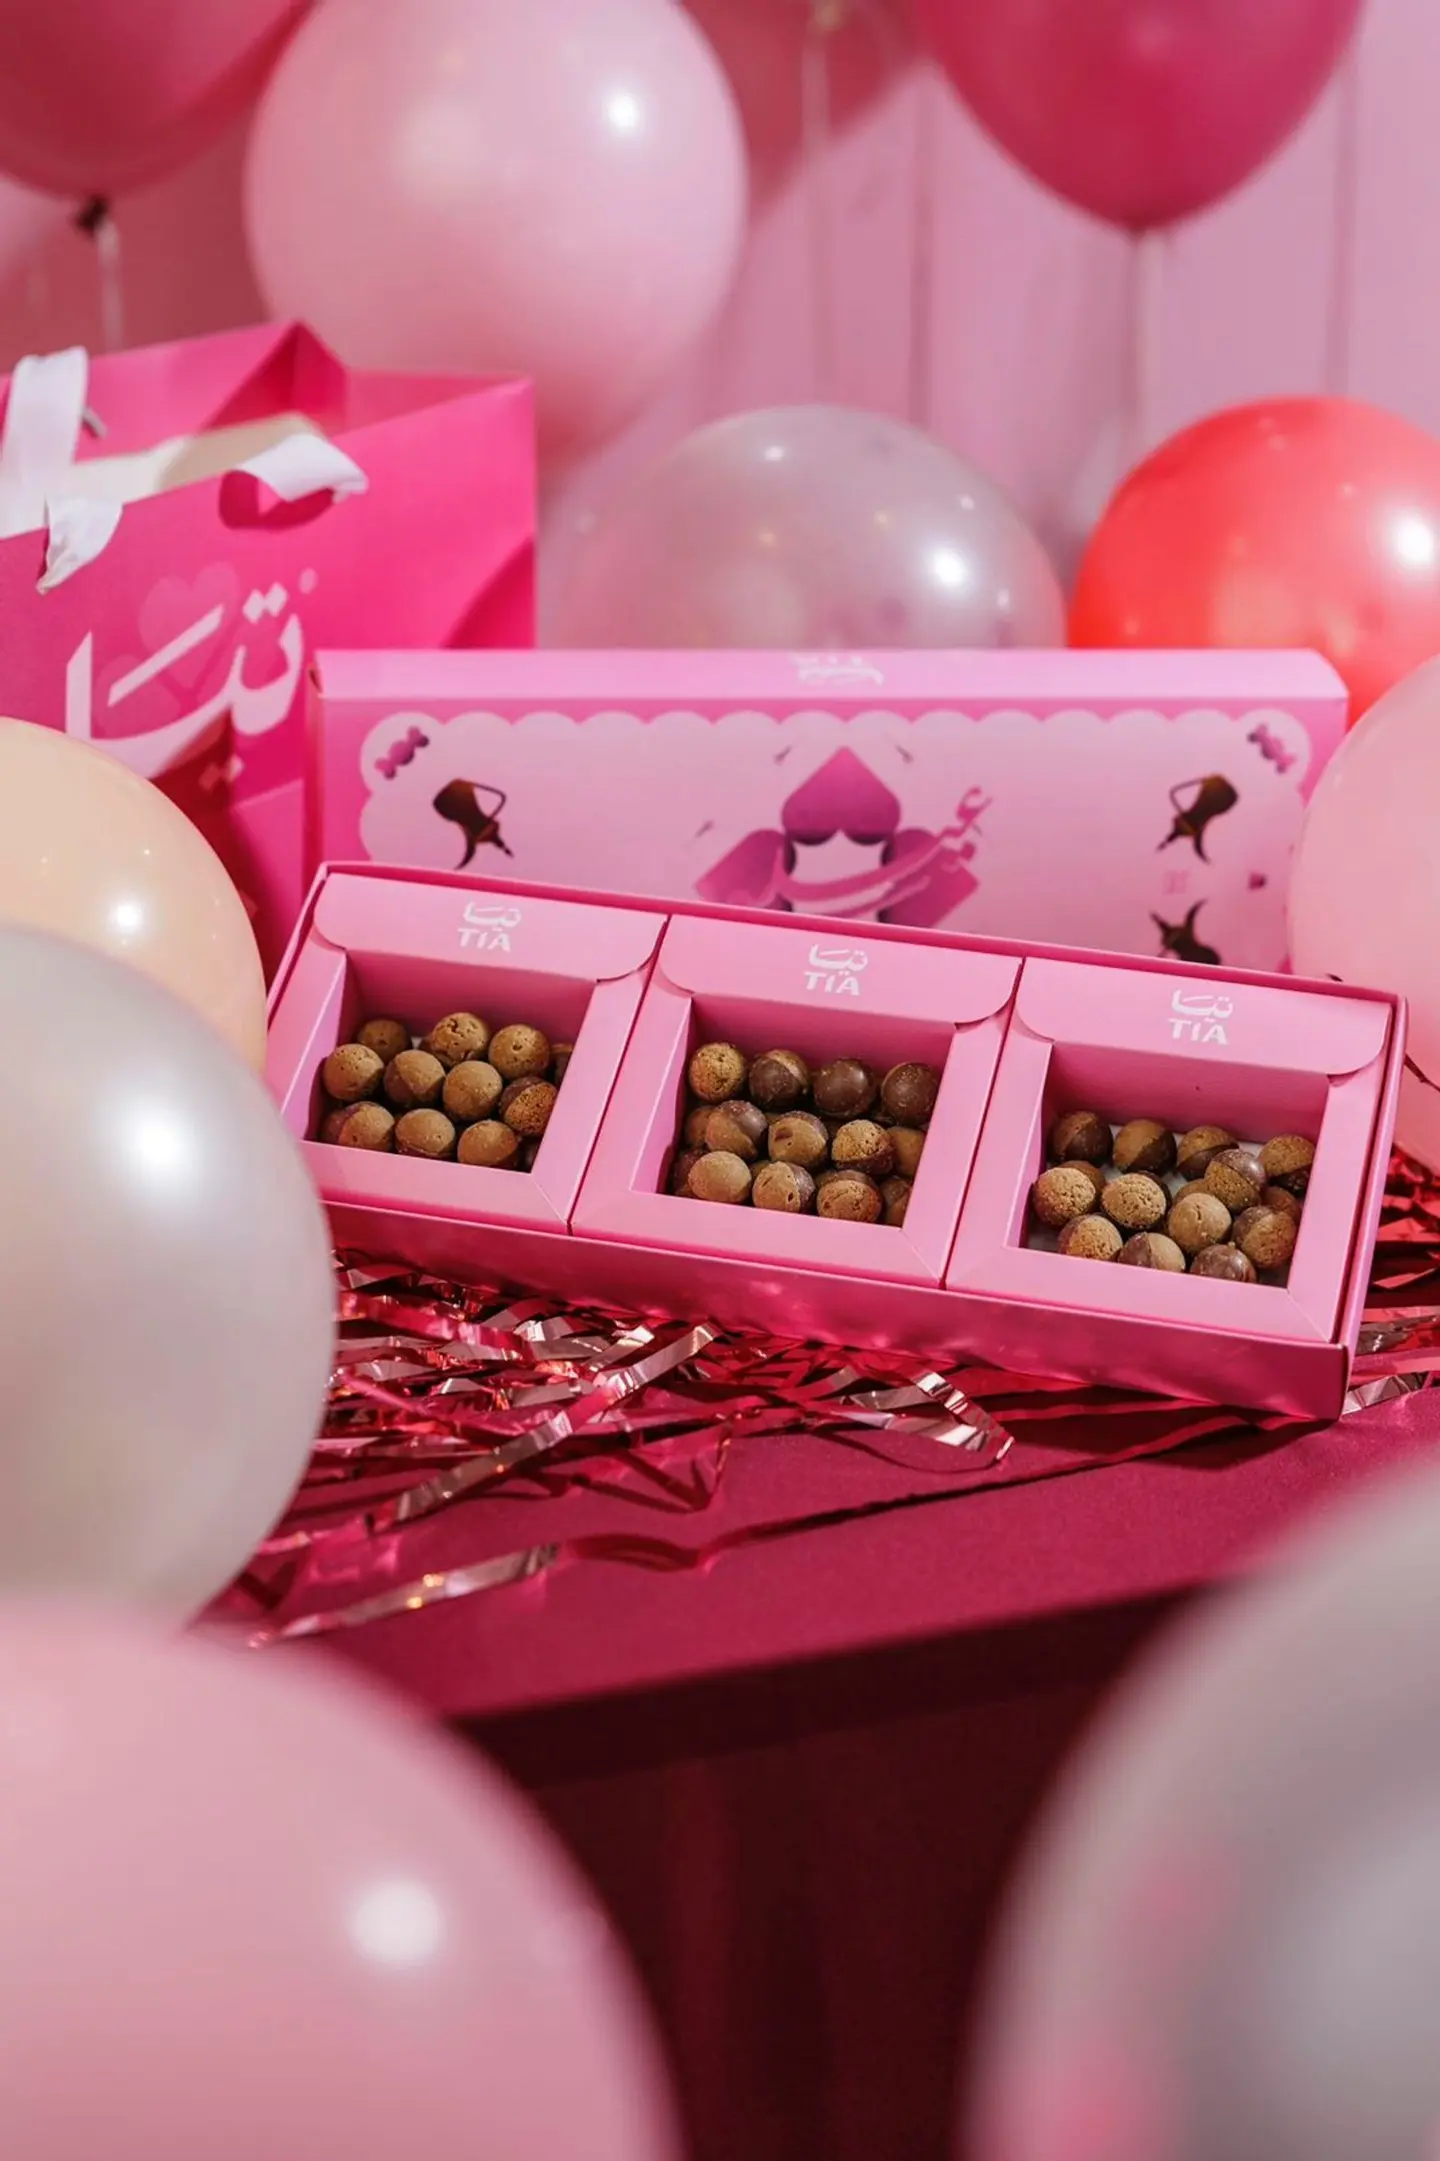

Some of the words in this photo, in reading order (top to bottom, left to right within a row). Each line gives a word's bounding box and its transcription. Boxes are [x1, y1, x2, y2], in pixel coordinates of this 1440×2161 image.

[457, 928, 511, 953] TIA
[804, 971, 860, 996] TIA
[1168, 1018, 1227, 1045] TIA
